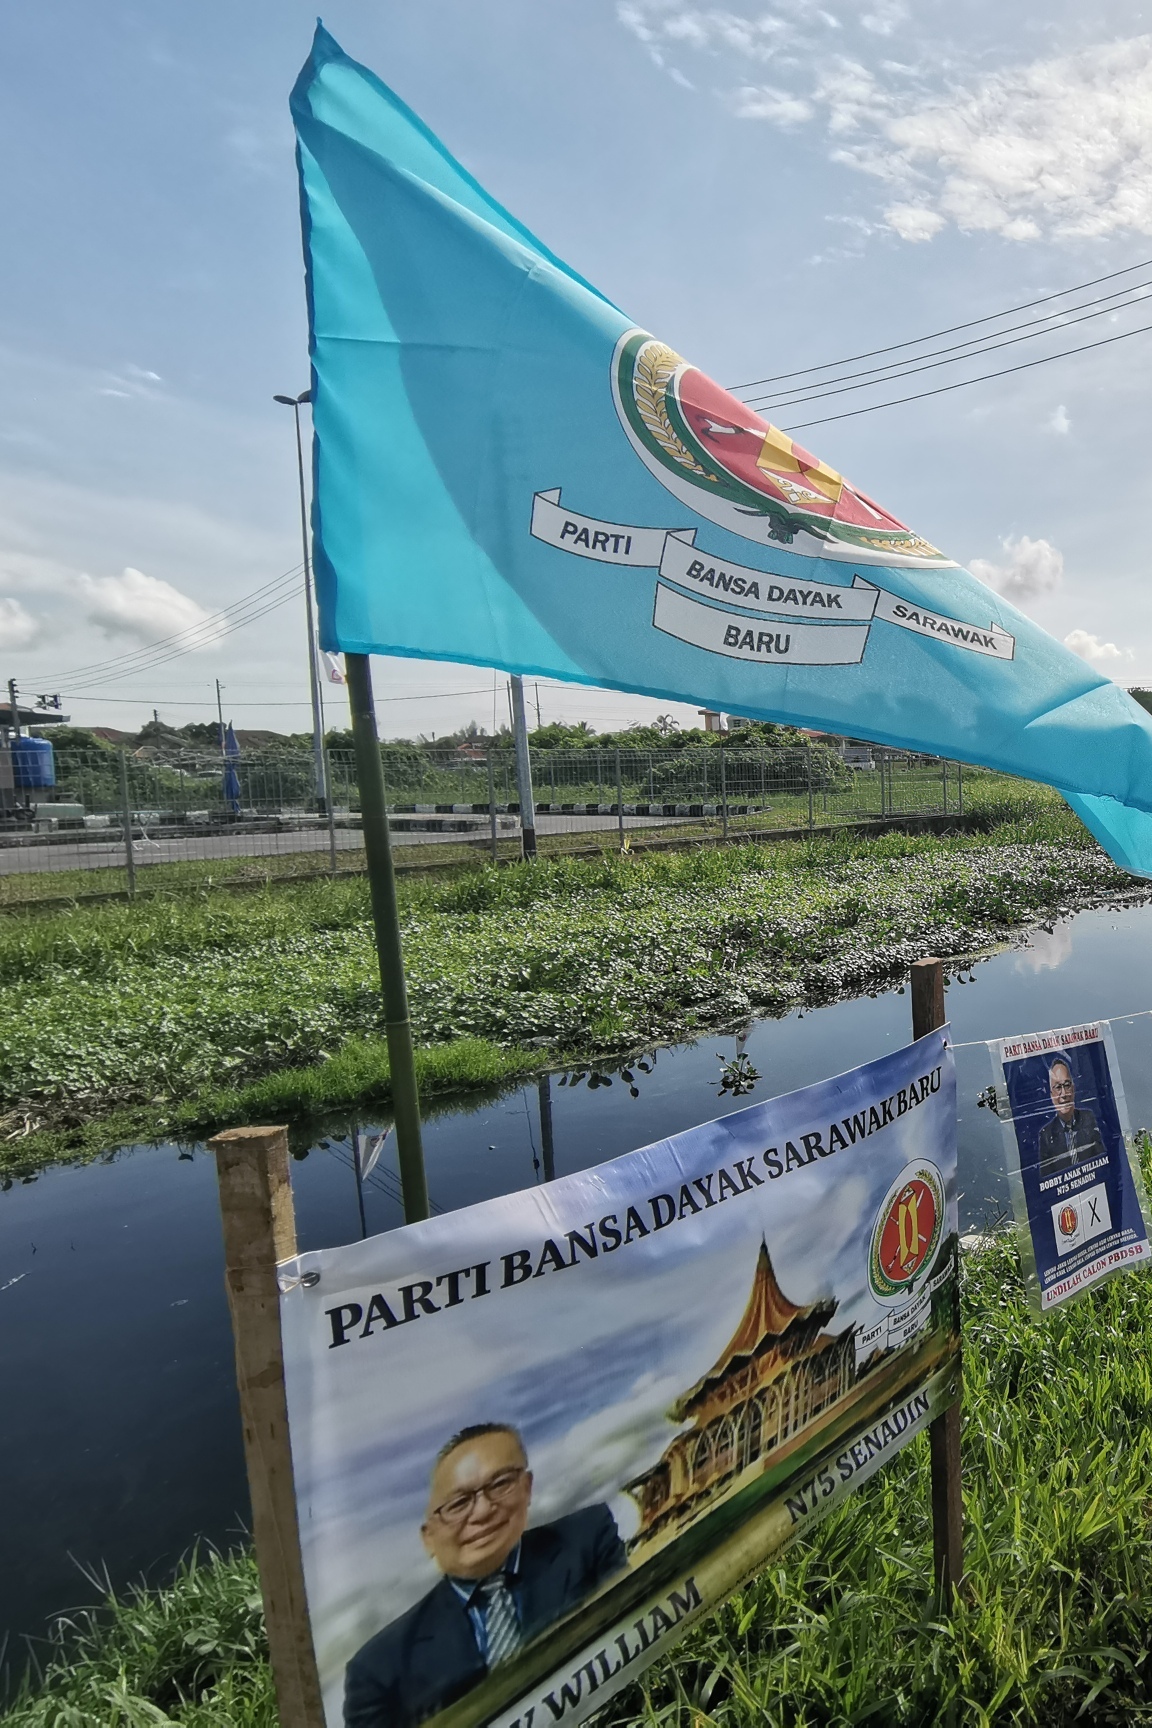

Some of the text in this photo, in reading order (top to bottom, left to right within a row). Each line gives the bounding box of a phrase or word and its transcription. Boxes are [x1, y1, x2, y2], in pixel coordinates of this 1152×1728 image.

[559, 521, 632, 555] PARTI
[686, 559, 844, 609] BANSA DAYAK
[722, 625, 791, 654] BARU
[892, 604, 998, 651] SARAWAK
[1004, 1043, 1022, 1058] PARTI
[1084, 1027, 1099, 1040] BARU
[1039, 1156, 1110, 1192] BOBBY ANAK WILLIAM
[1056, 1171, 1096, 1196] N75 SENADIN
[325, 1066, 943, 1350] PARTI BANSA DAYAK SARAWAK BARU
[1046, 1244, 1144, 1302] UNDILAH CALON PBDSB
[861, 1326, 882, 1344] PARTI
[893, 1311, 910, 1325] BANSA
[903, 1320, 919, 1337] BARU
[784, 1388, 931, 1525] N75 SENADIN
[748, 1550, 778, 1574] Printing
[541, 1576, 704, 1721] WILLIAM
